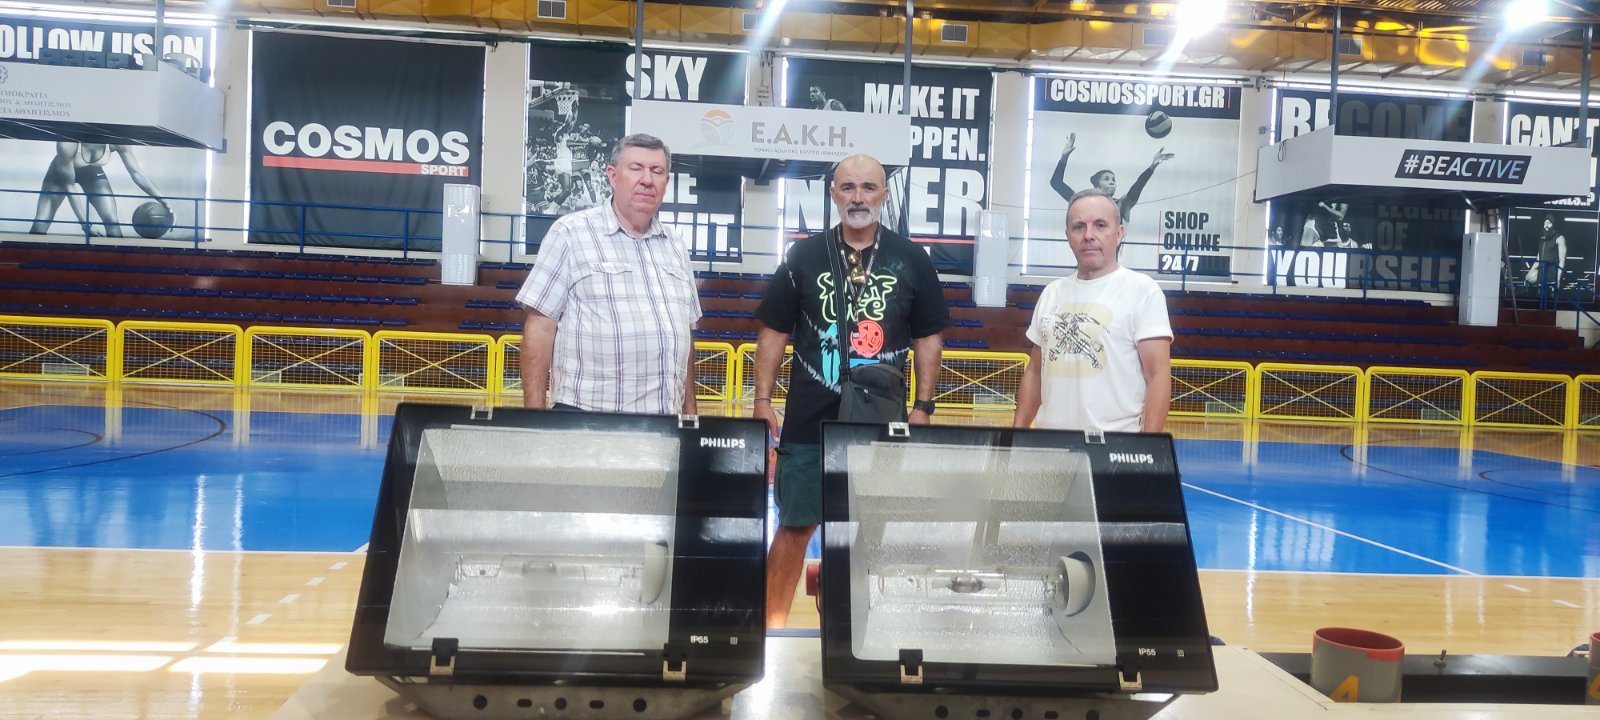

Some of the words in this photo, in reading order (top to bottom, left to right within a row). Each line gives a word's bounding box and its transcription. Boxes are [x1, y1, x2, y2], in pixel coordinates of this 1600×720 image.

[625, 53, 707, 101] SKY
[864, 83, 944, 119] MAKE
[951, 88, 980, 120] IT
[1050, 79, 1225, 108] COSMOSSPORT.GR
[263, 121, 469, 164] COSMOS
[752, 121, 854, 148] Ε.Α.Κ.Η.
[421, 164, 467, 176] SPORT
[1404, 154, 1525, 180] #BEACTIVE
[785, 167, 984, 237] NER
[1164, 211, 1209, 230] SHOP
[1163, 232, 1220, 252] ONLINE
[1162, 255, 1199, 273] 24/7
[1271, 250, 1456, 292] YOURSELF
[700, 437, 746, 448] PHILIPS
[1109, 452, 1154, 464] PHILIPS
[1138, 647, 1156, 656] IP55
